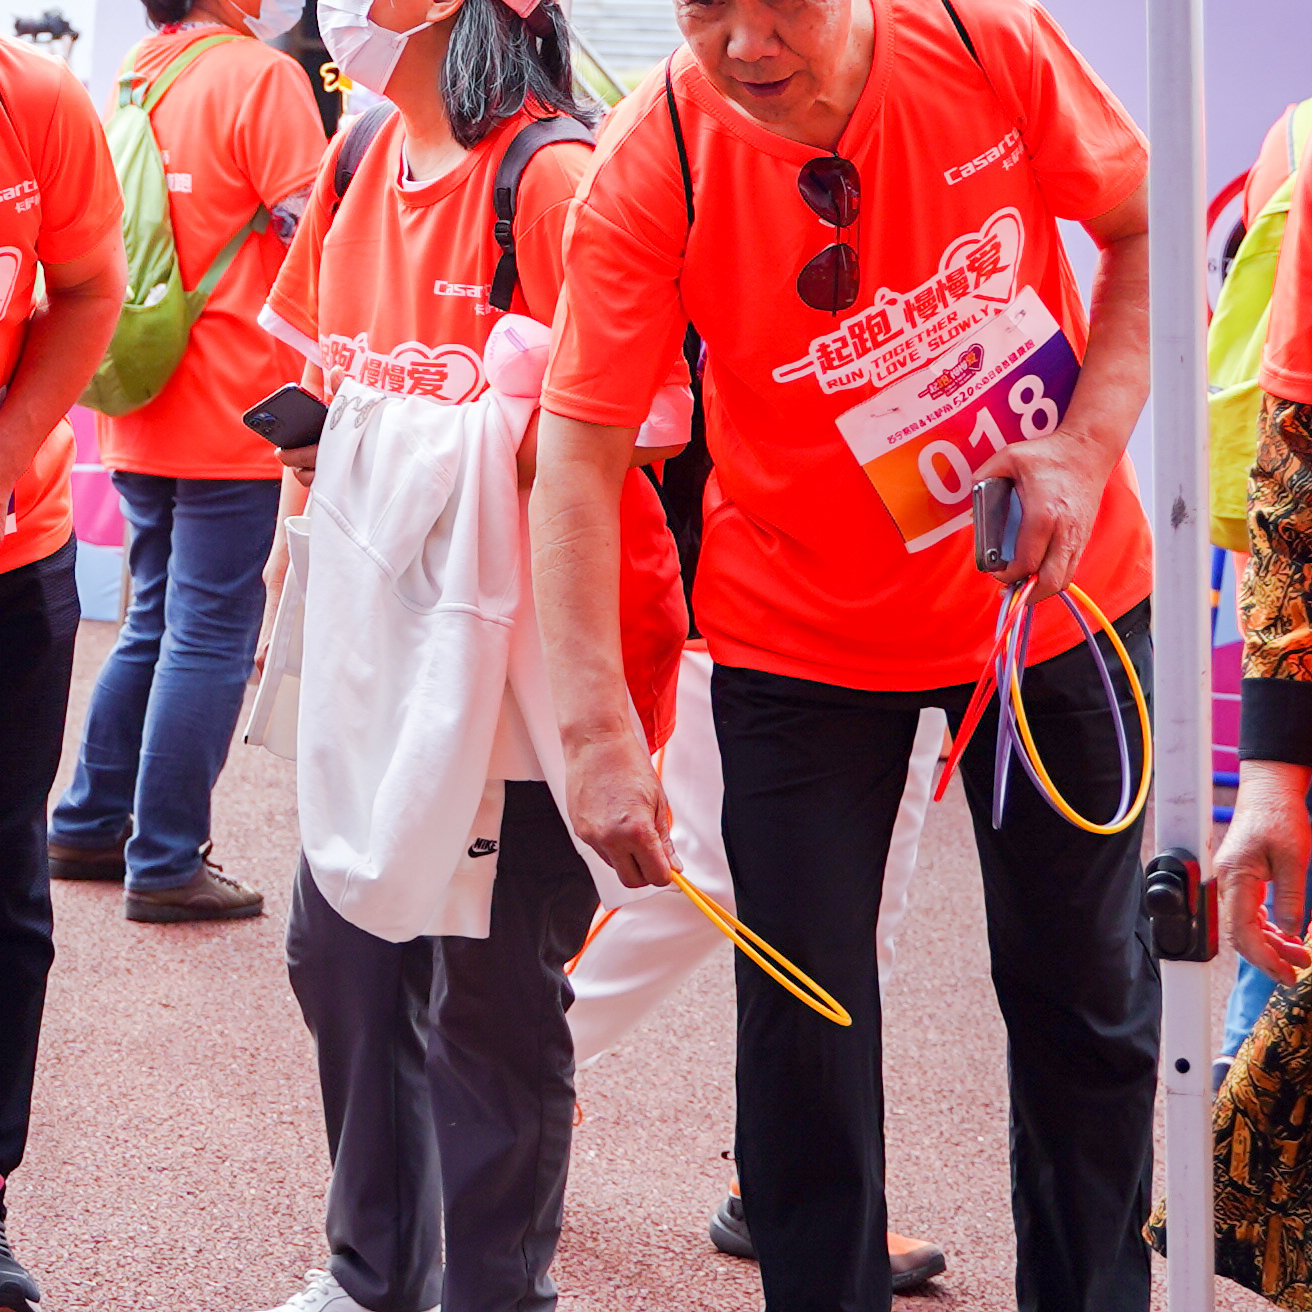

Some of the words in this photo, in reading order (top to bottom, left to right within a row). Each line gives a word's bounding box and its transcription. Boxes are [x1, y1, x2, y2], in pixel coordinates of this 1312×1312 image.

[826, 368, 865, 390] RUN
[870, 310, 959, 369] TOGETHER
[877, 348, 922, 382] LOVE
[926, 304, 989, 352] SLOWLY
[917, 373, 1059, 505] 018
